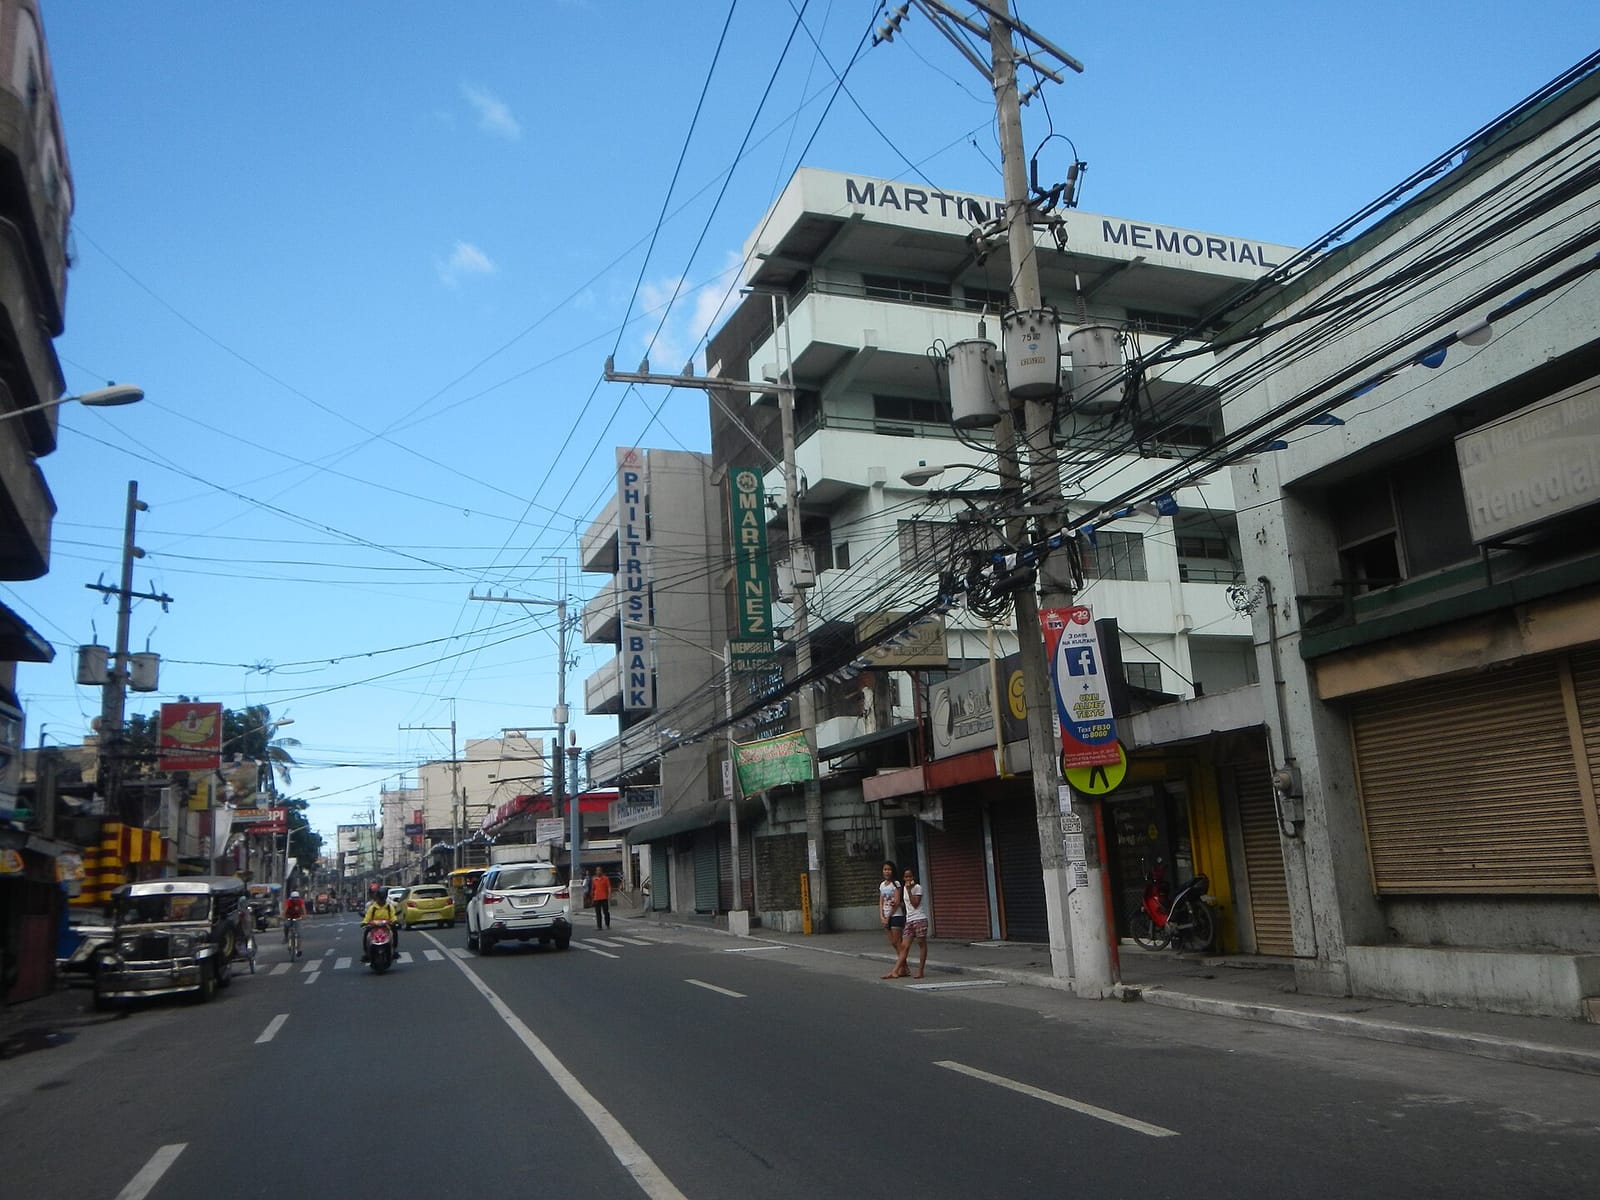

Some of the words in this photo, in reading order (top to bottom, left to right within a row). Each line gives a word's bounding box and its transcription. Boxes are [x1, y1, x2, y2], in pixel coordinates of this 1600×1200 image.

[846, 178, 1046, 231] MARTIN
[1102, 220, 1278, 269] MEMORIAL
[623, 471, 643, 623] PHILTRUST
[739, 493, 766, 633] MARTINEZ
[629, 636, 646, 706] BANK
[1073, 701, 1105, 711] ALLNET
[1076, 709, 1105, 718] TEXTS
